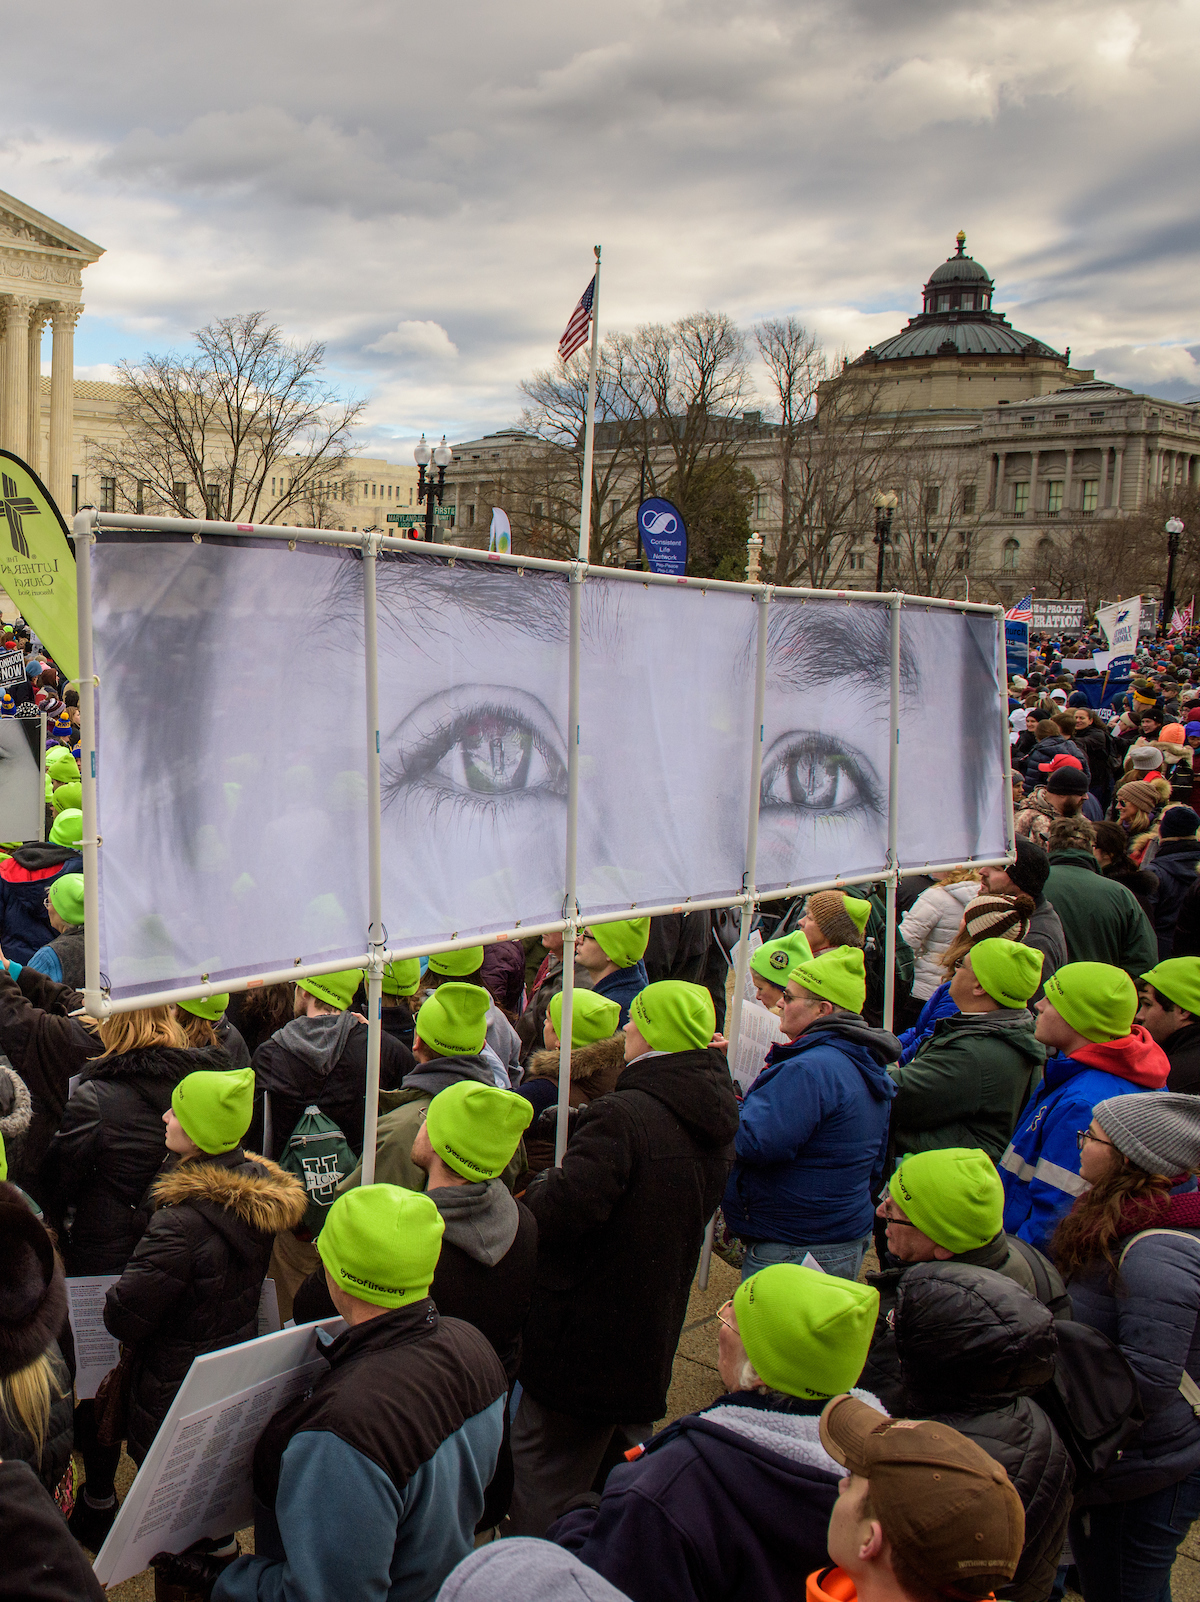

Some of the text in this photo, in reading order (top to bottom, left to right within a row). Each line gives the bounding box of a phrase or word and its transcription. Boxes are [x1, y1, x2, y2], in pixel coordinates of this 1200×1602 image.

[650, 538, 682, 546] Consistent
[1046, 604, 1083, 614] PRO-LIFE
[1, 664, 22, 680] NOW
[306, 978, 342, 1000] eyesoflife.org
[434, 1038, 476, 1052] eyesoflife.org
[444, 1144, 493, 1177] eyesoflife.org
[340, 1267, 406, 1297] eyesoflife.org
